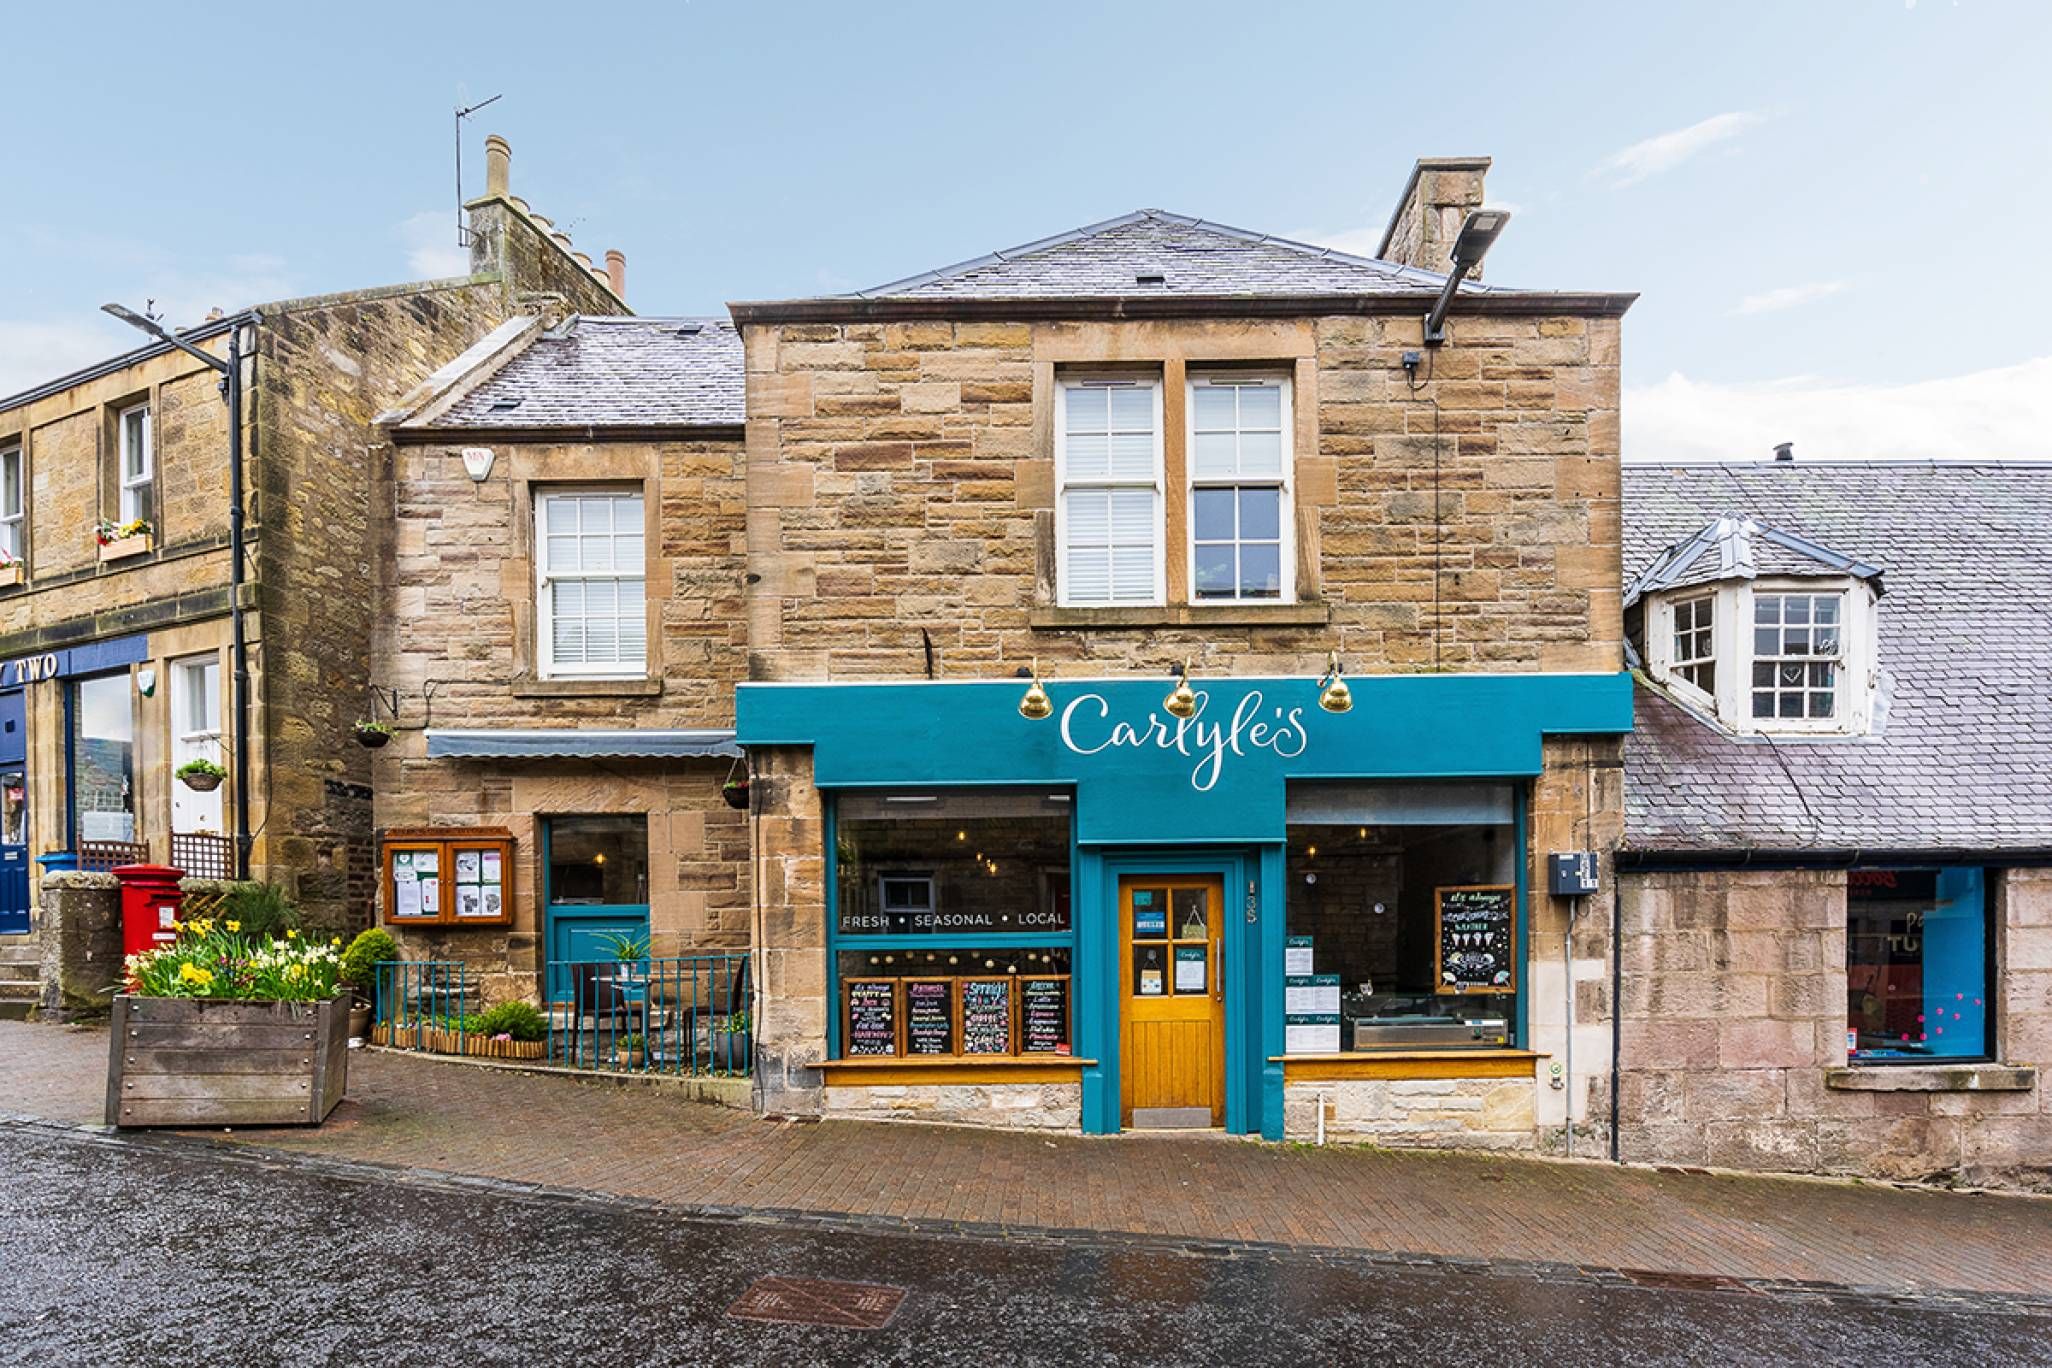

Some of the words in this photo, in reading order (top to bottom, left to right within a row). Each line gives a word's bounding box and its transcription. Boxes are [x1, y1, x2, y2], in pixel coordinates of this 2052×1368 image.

[15, 653, 57, 683] TWO
[1060, 690, 1307, 791] Carlyle's
[842, 916, 890, 928] FRESH
[914, 914, 993, 926] SEASONAL
[1018, 912, 1065, 924] LOCAL
